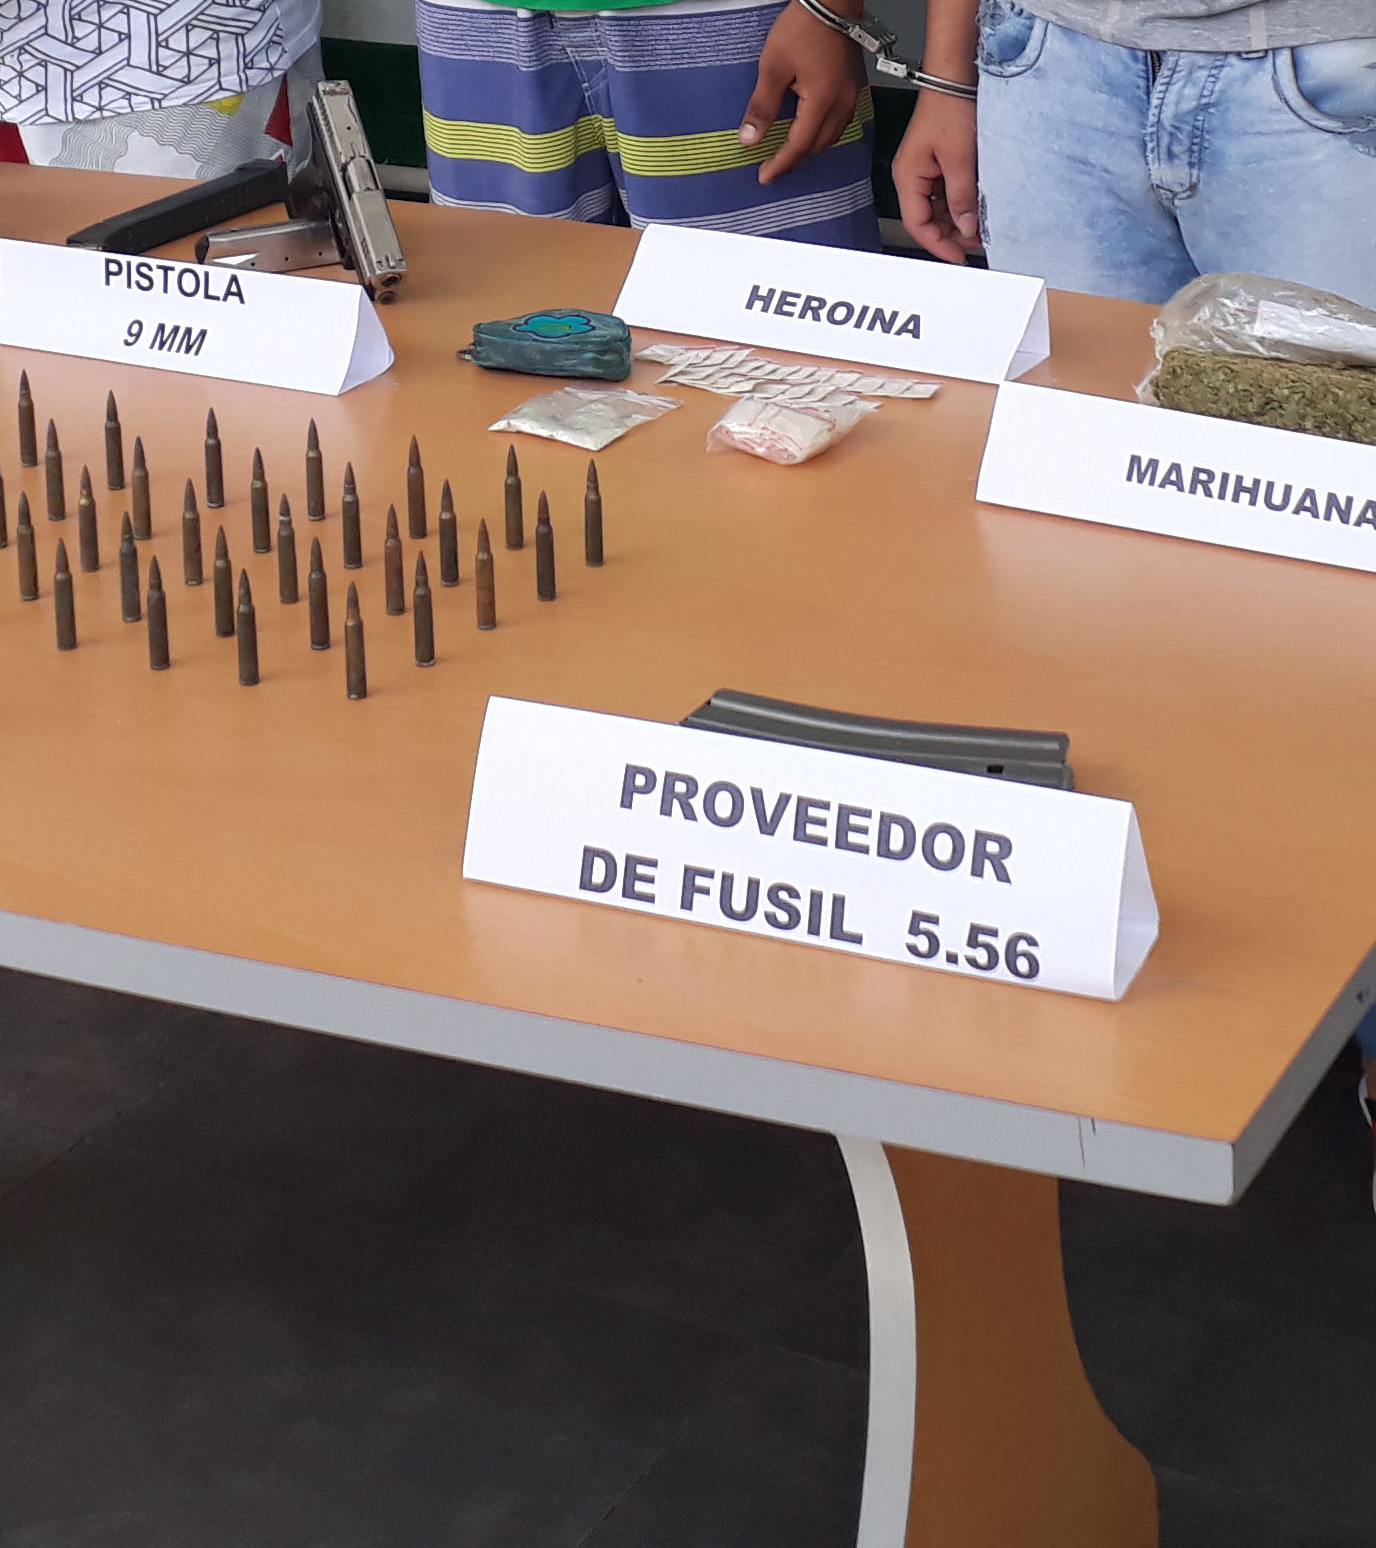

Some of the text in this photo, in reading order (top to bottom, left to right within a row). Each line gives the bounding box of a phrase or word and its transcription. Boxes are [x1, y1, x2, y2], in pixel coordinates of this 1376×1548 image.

[103, 257, 246, 305] PISTOLA
[123, 319, 208, 356] 9 MM
[745, 284, 923, 340] HEROINA
[619, 762, 1014, 885] PROVEEDOR
[578, 844, 1042, 981] DE FUSIL 5.56
